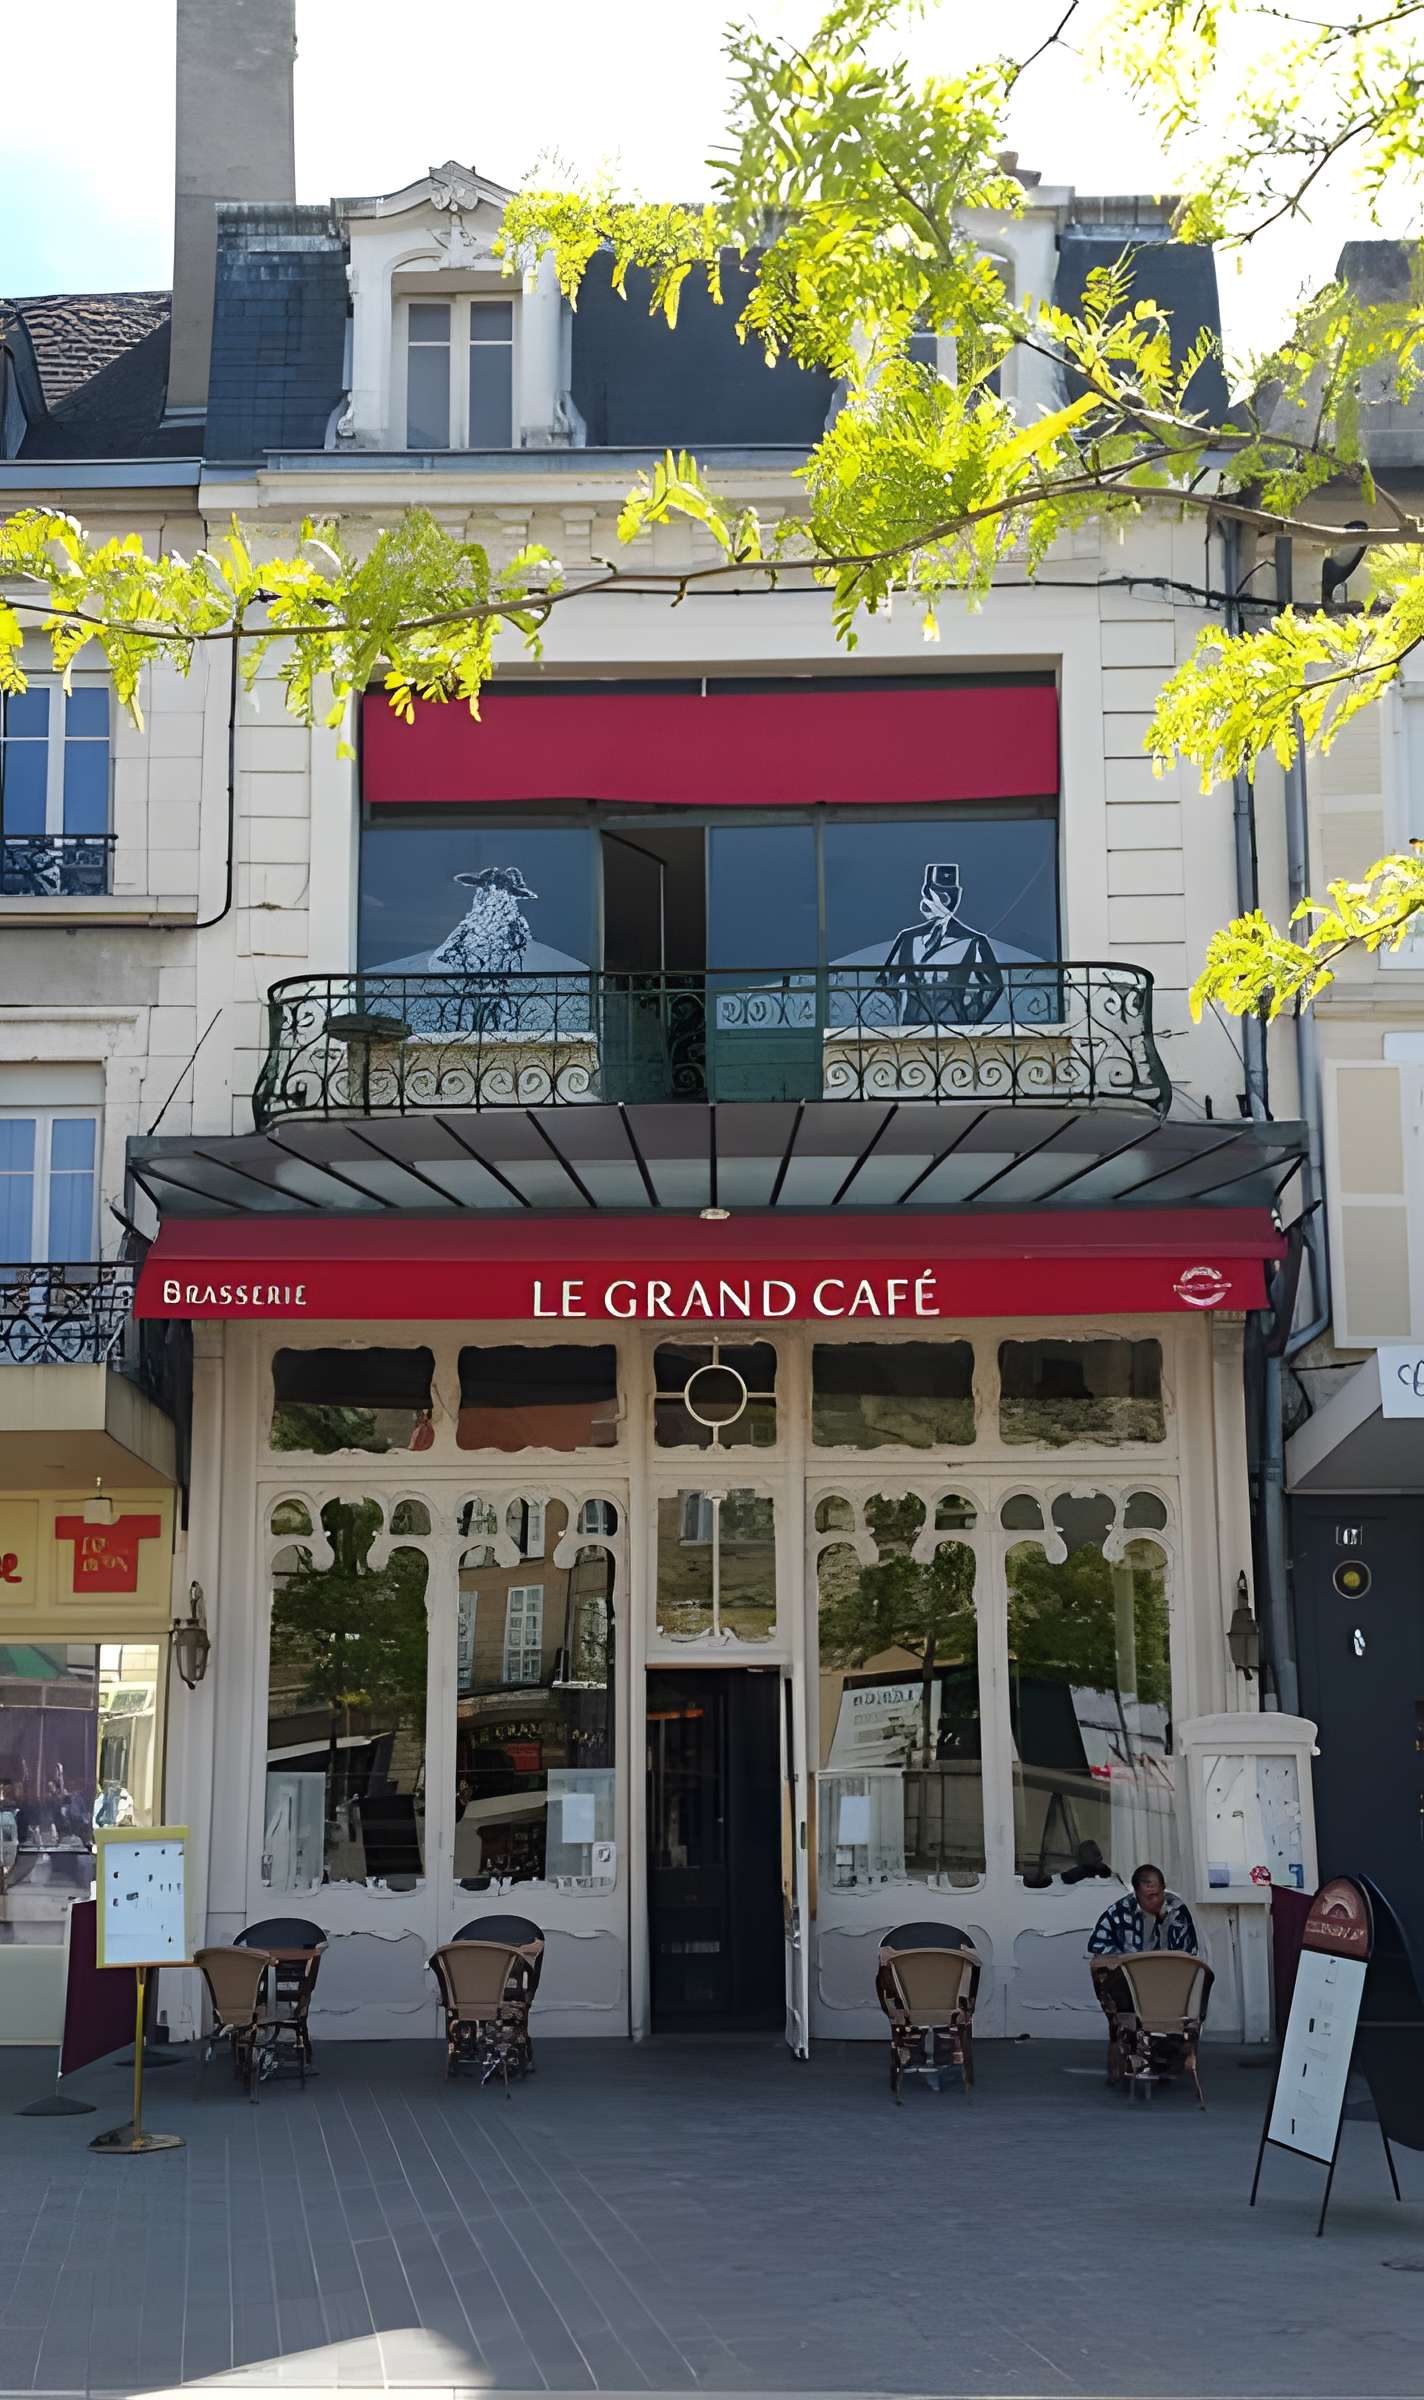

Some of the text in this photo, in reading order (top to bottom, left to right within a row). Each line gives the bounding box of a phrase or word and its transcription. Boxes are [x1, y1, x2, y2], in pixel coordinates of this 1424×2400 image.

[533, 1268, 941, 1318] LE GRAND CAFÉ
